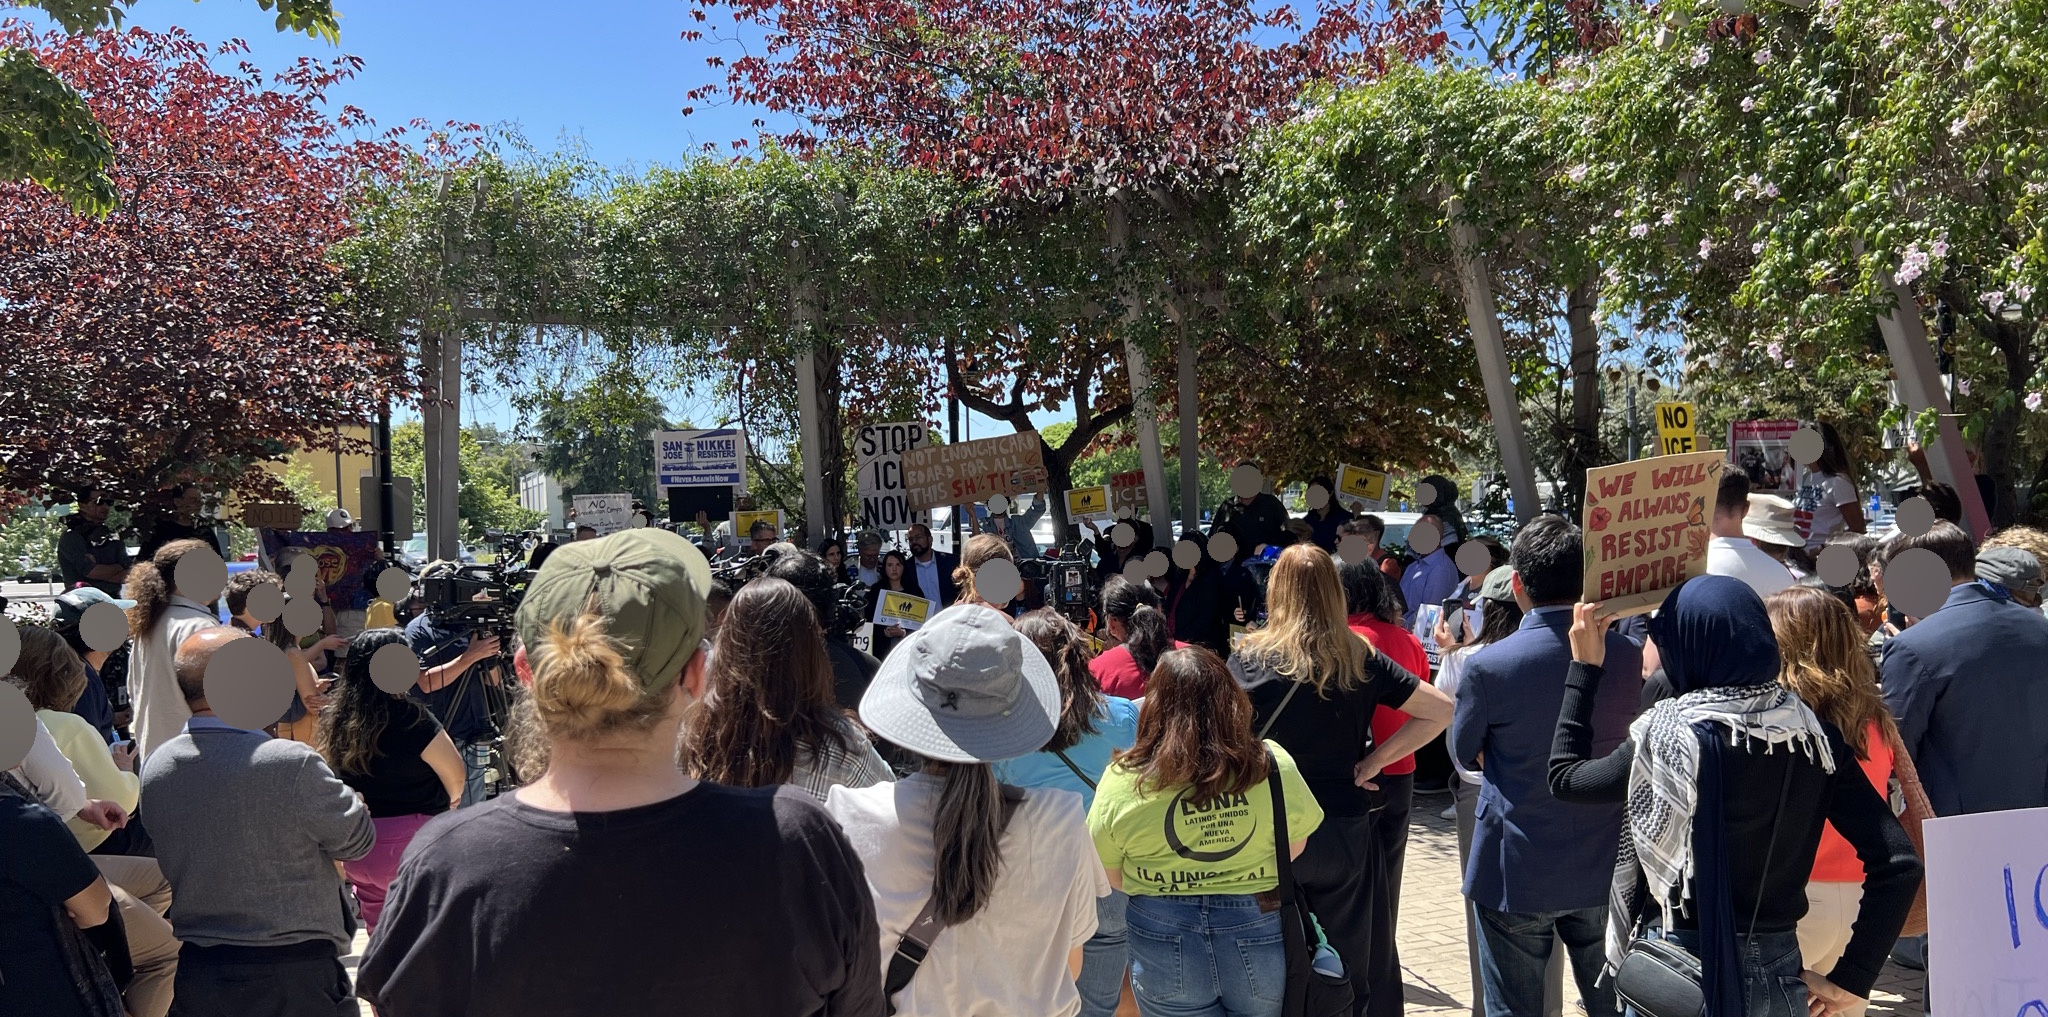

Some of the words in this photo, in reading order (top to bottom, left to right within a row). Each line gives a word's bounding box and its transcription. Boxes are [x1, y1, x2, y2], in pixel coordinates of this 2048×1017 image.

[1663, 406, 1688, 429] NO
[662, 440, 683, 452] SAN
[697, 439, 736, 451] NIKKEI
[861, 425, 922, 456] STOP
[1665, 437, 1692, 455] ICE
[663, 451, 683, 460] JOSE
[697, 450, 736, 459] RESISTERS
[903, 448, 936, 468] NOT
[941, 439, 997, 463] ENOUGH
[908, 465, 955, 486] BOARD
[961, 460, 989, 478] FOR
[993, 455, 1023, 473] ALL
[1111, 471, 1146, 487] STOP
[1598, 471, 1637, 499] WE
[1652, 462, 1706, 490] WILL
[910, 482, 948, 506] THIS
[1115, 486, 1146, 503] ICE
[588, 499, 606, 509] NO
[863, 495, 928, 525] NOW!
[1617, 492, 1691, 523] ALWAYS
[1601, 521, 1690, 563] RESIST
[1600, 552, 1688, 601] EMPIRE
[1184, 813, 1217, 826] LATINOS
[1219, 809, 1249, 819] UNIDOS
[1217, 820, 1235, 828] UNA
[1199, 836, 1236, 847] AMERICA
[1204, 829, 1230, 838] NUEVA
